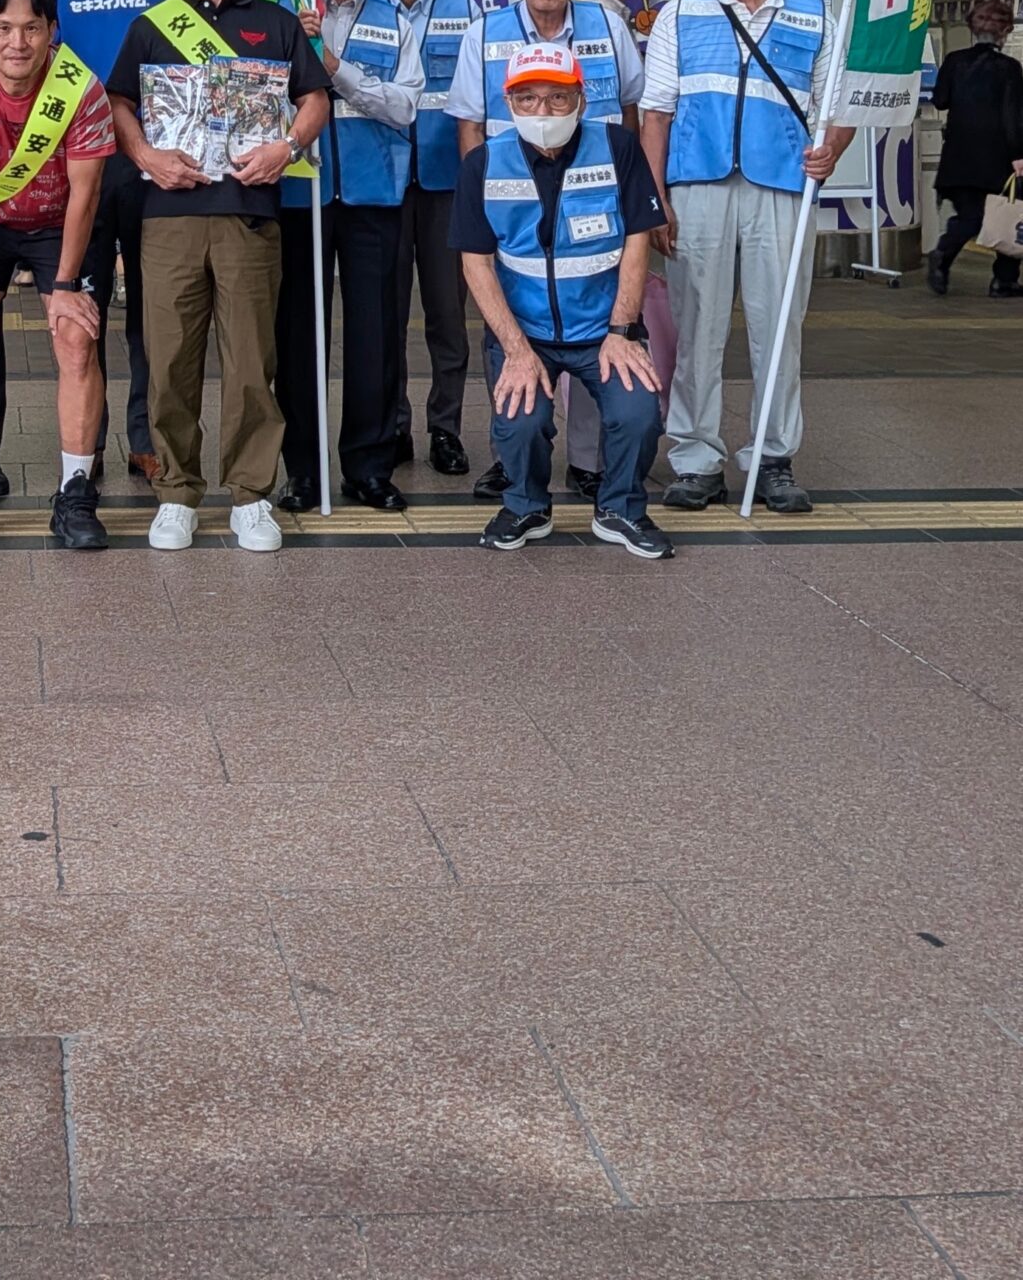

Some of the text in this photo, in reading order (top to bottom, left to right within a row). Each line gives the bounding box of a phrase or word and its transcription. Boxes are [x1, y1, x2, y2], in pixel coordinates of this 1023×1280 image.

[5, 60, 83, 179] 交通安全
[566, 171, 612, 186] 交通安全協会
